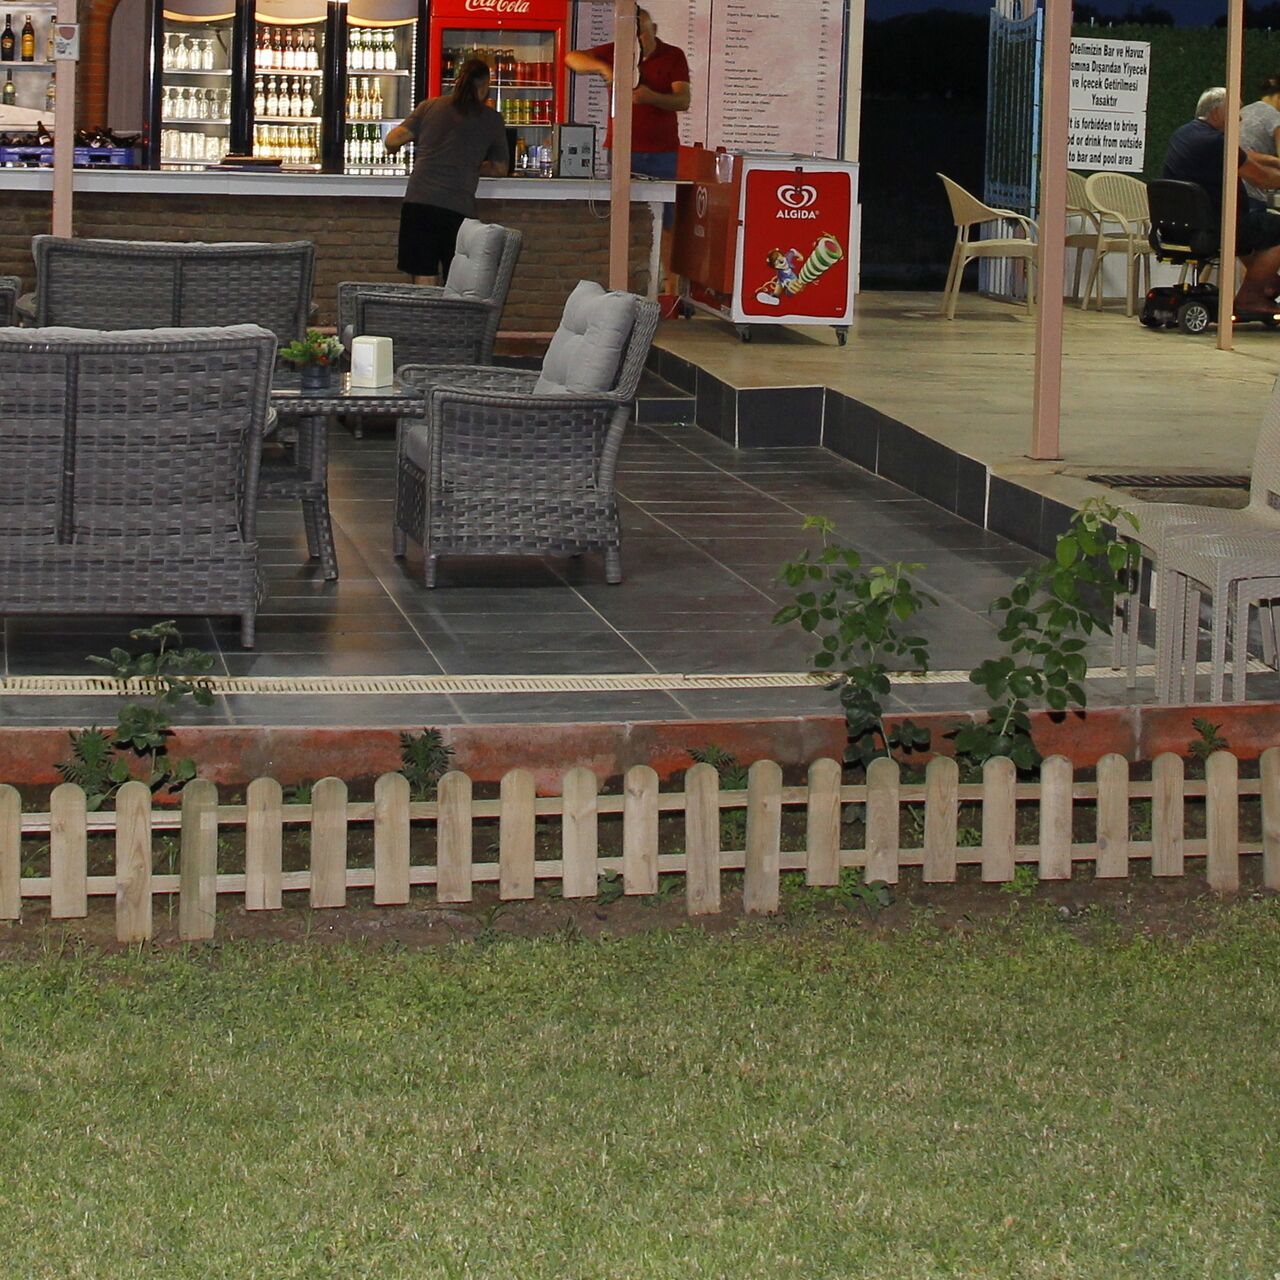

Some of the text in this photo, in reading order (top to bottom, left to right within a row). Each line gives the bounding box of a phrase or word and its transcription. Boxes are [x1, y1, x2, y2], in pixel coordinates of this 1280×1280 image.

[1103, 44, 1115, 57] Bar
[1116, 47, 1124, 57] ve
[1125, 46, 1144, 59] Havuz
[1072, 78, 1079, 88] ve
[1074, 117, 1080, 129] is
[1081, 117, 1112, 131] forbidden
[1113, 120, 1120, 131] to
[1121, 120, 1138, 135] bring
[1076, 136, 1084, 146] or
[1085, 134, 1101, 147] drink
[1102, 135, 1118, 148] from
[1119, 136, 1142, 149] outside
[1068, 150, 1132, 167] to bar and pool area
